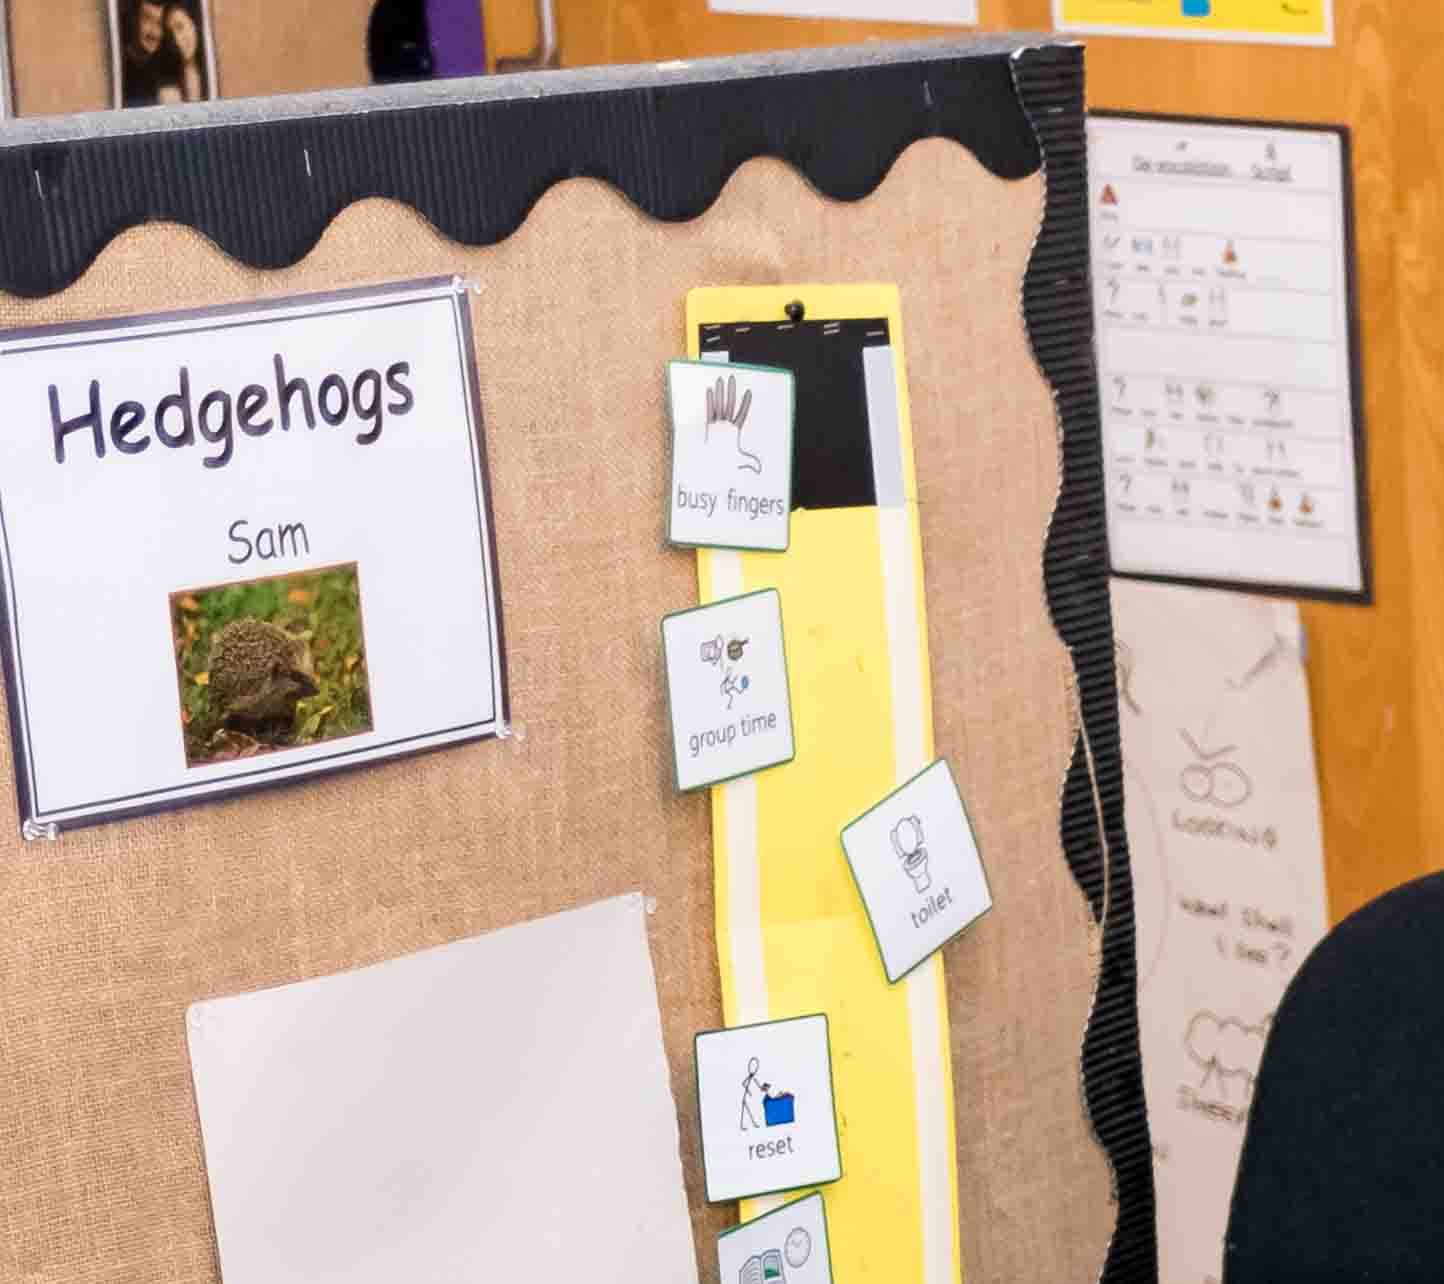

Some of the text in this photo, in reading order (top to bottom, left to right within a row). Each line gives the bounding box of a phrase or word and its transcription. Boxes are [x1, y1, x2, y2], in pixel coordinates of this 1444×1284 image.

[48, 354, 414, 468] Hedgehogs
[677, 482, 784, 520] busy fingers
[227, 519, 310, 565] Sam
[689, 712, 777, 757] group time
[911, 887, 953, 928] toilet
[749, 1136, 794, 1160] reset
